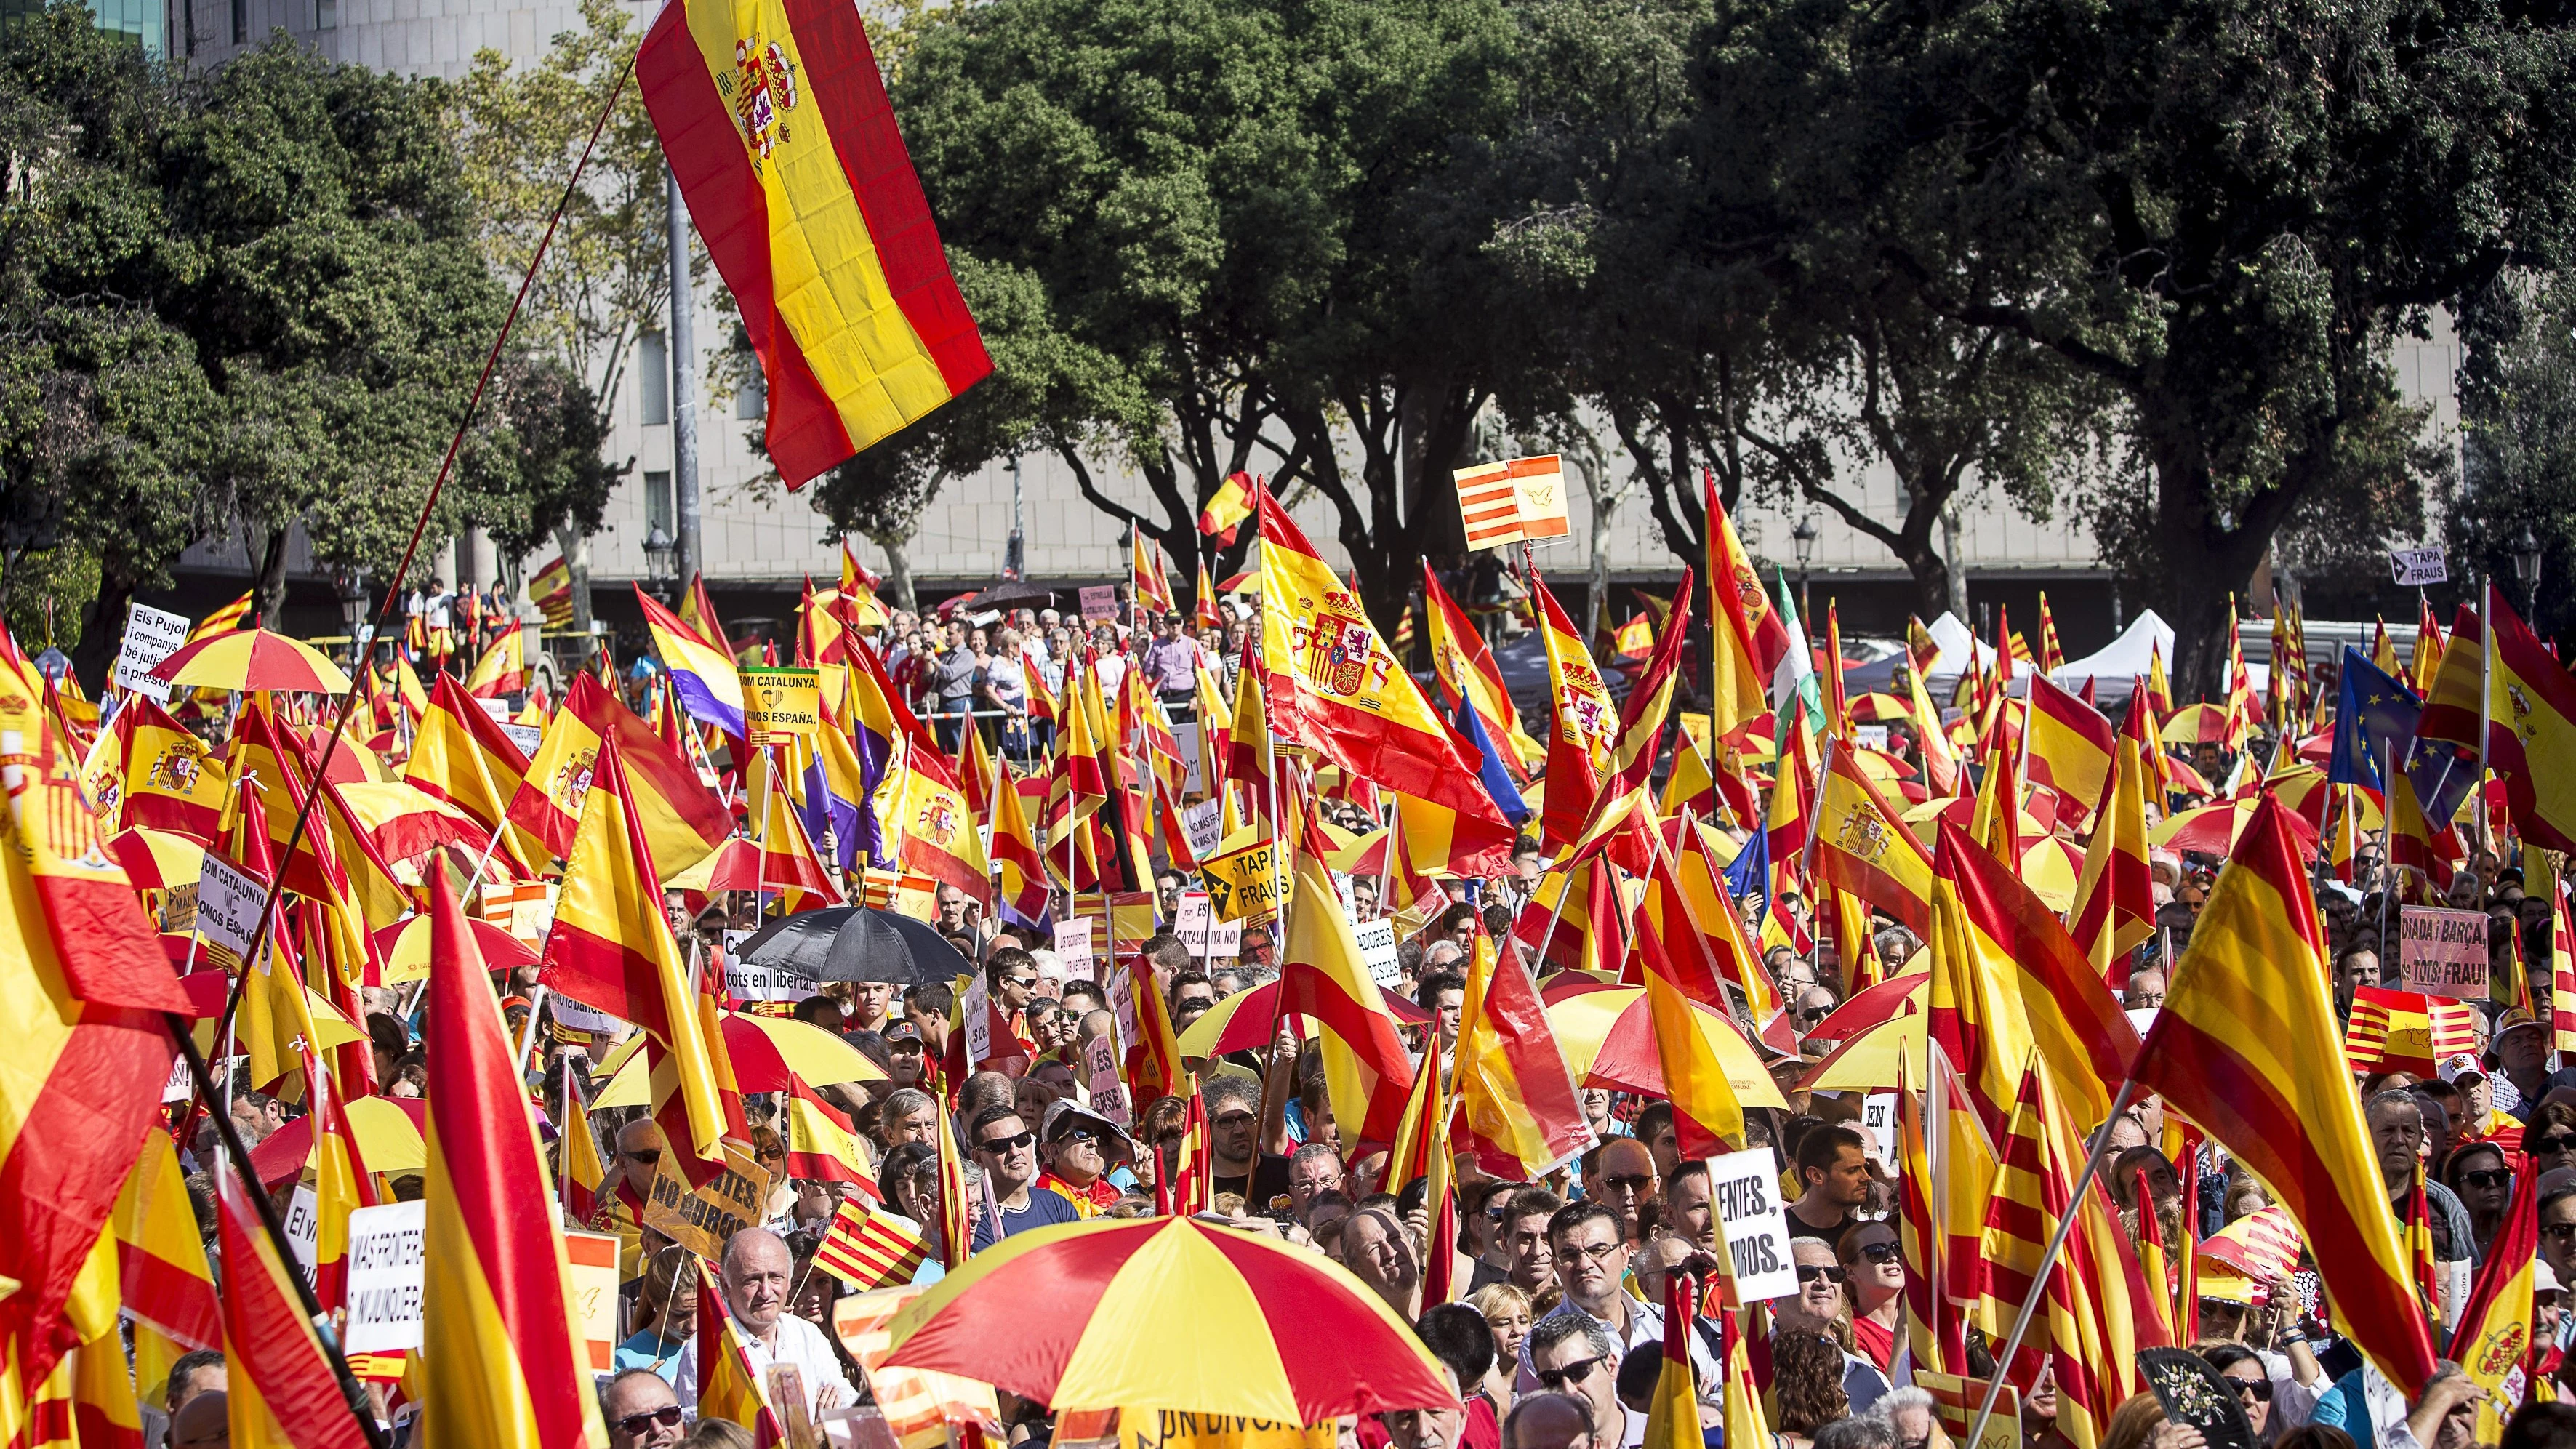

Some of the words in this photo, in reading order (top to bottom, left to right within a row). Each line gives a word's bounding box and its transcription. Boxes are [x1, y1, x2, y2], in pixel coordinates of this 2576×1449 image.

[2411, 566, 2444, 581] FRAUS
[135, 609, 152, 625] Els
[155, 615, 187, 636] Pujol
[129, 626, 135, 638] i
[135, 630, 178, 654] companys
[124, 643, 138, 660] bé
[137, 649, 163, 669] jutja
[121, 665, 128, 676] a
[739, 675, 755, 687] SOM
[757, 676, 819, 689] CATALUNYA.
[747, 709, 769, 723] SOMOS
[771, 711, 816, 725] ESPAÑA.
[1189, 822, 1199, 835] NO
[1198, 816, 1211, 830] MÁS
[1239, 875, 1290, 907] FRAUS
[176, 895, 191, 912] MAL
[198, 899, 224, 928] OMOS
[226, 916, 254, 945] ESPAÑ
[2402, 917, 2433, 942] DIADA
[2441, 920, 2487, 950] BARÇA,
[1176, 929, 1222, 948] CATALUYA,
[1224, 929, 1238, 944] NO!
[1357, 927, 1392, 951] ADORES
[726, 969, 748, 988] tots
[752, 974, 766, 988] en
[1369, 958, 1400, 982] ISTAS
[2444, 961, 2487, 985] FRAU!
[1866, 1105, 1885, 1128] EN
[653, 1173, 680, 1210] NO
[1715, 1175, 1777, 1222] ENTES,
[289, 1206, 307, 1235] El
